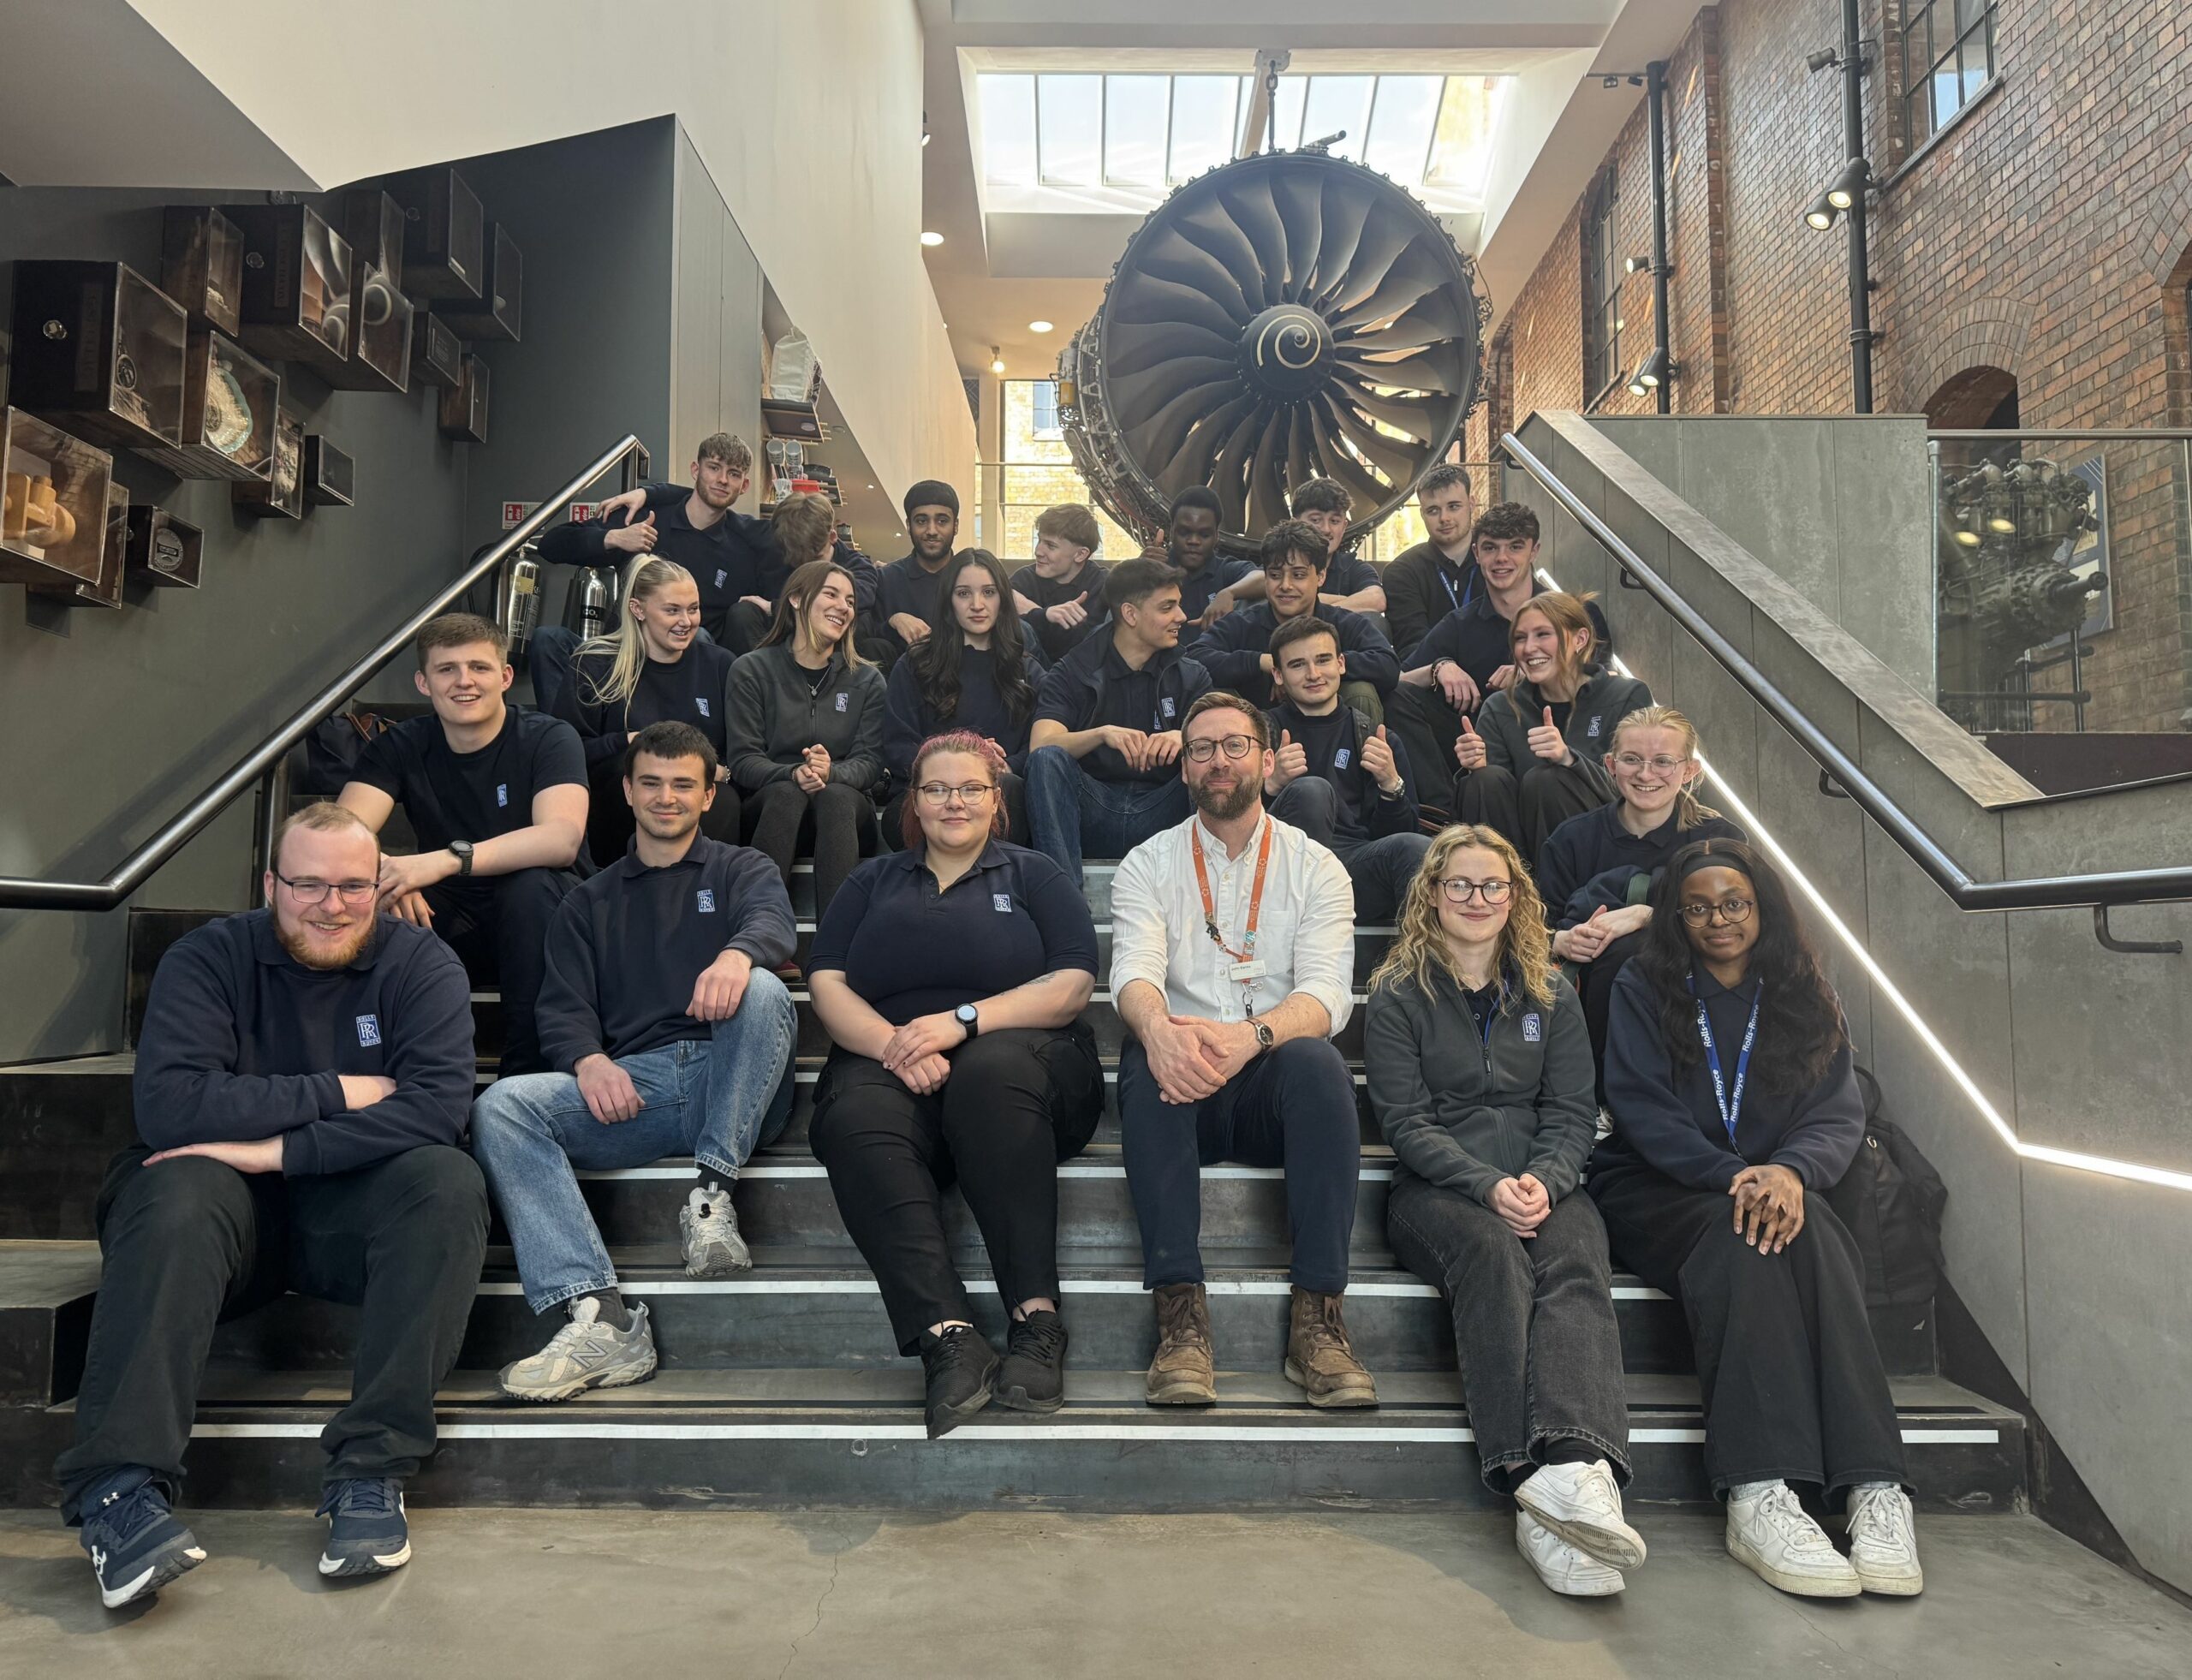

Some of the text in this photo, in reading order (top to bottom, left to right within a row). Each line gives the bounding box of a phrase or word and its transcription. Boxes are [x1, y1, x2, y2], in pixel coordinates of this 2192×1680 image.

[360, 1022, 377, 1040] RR
[1524, 1020, 1539, 1035] RR
[1742, 1004, 1760, 1052] Rolls-Royce
[1712, 1069, 1728, 1121] Rolls-Royce
[1730, 1072, 1744, 1123] Rolls-Royce
